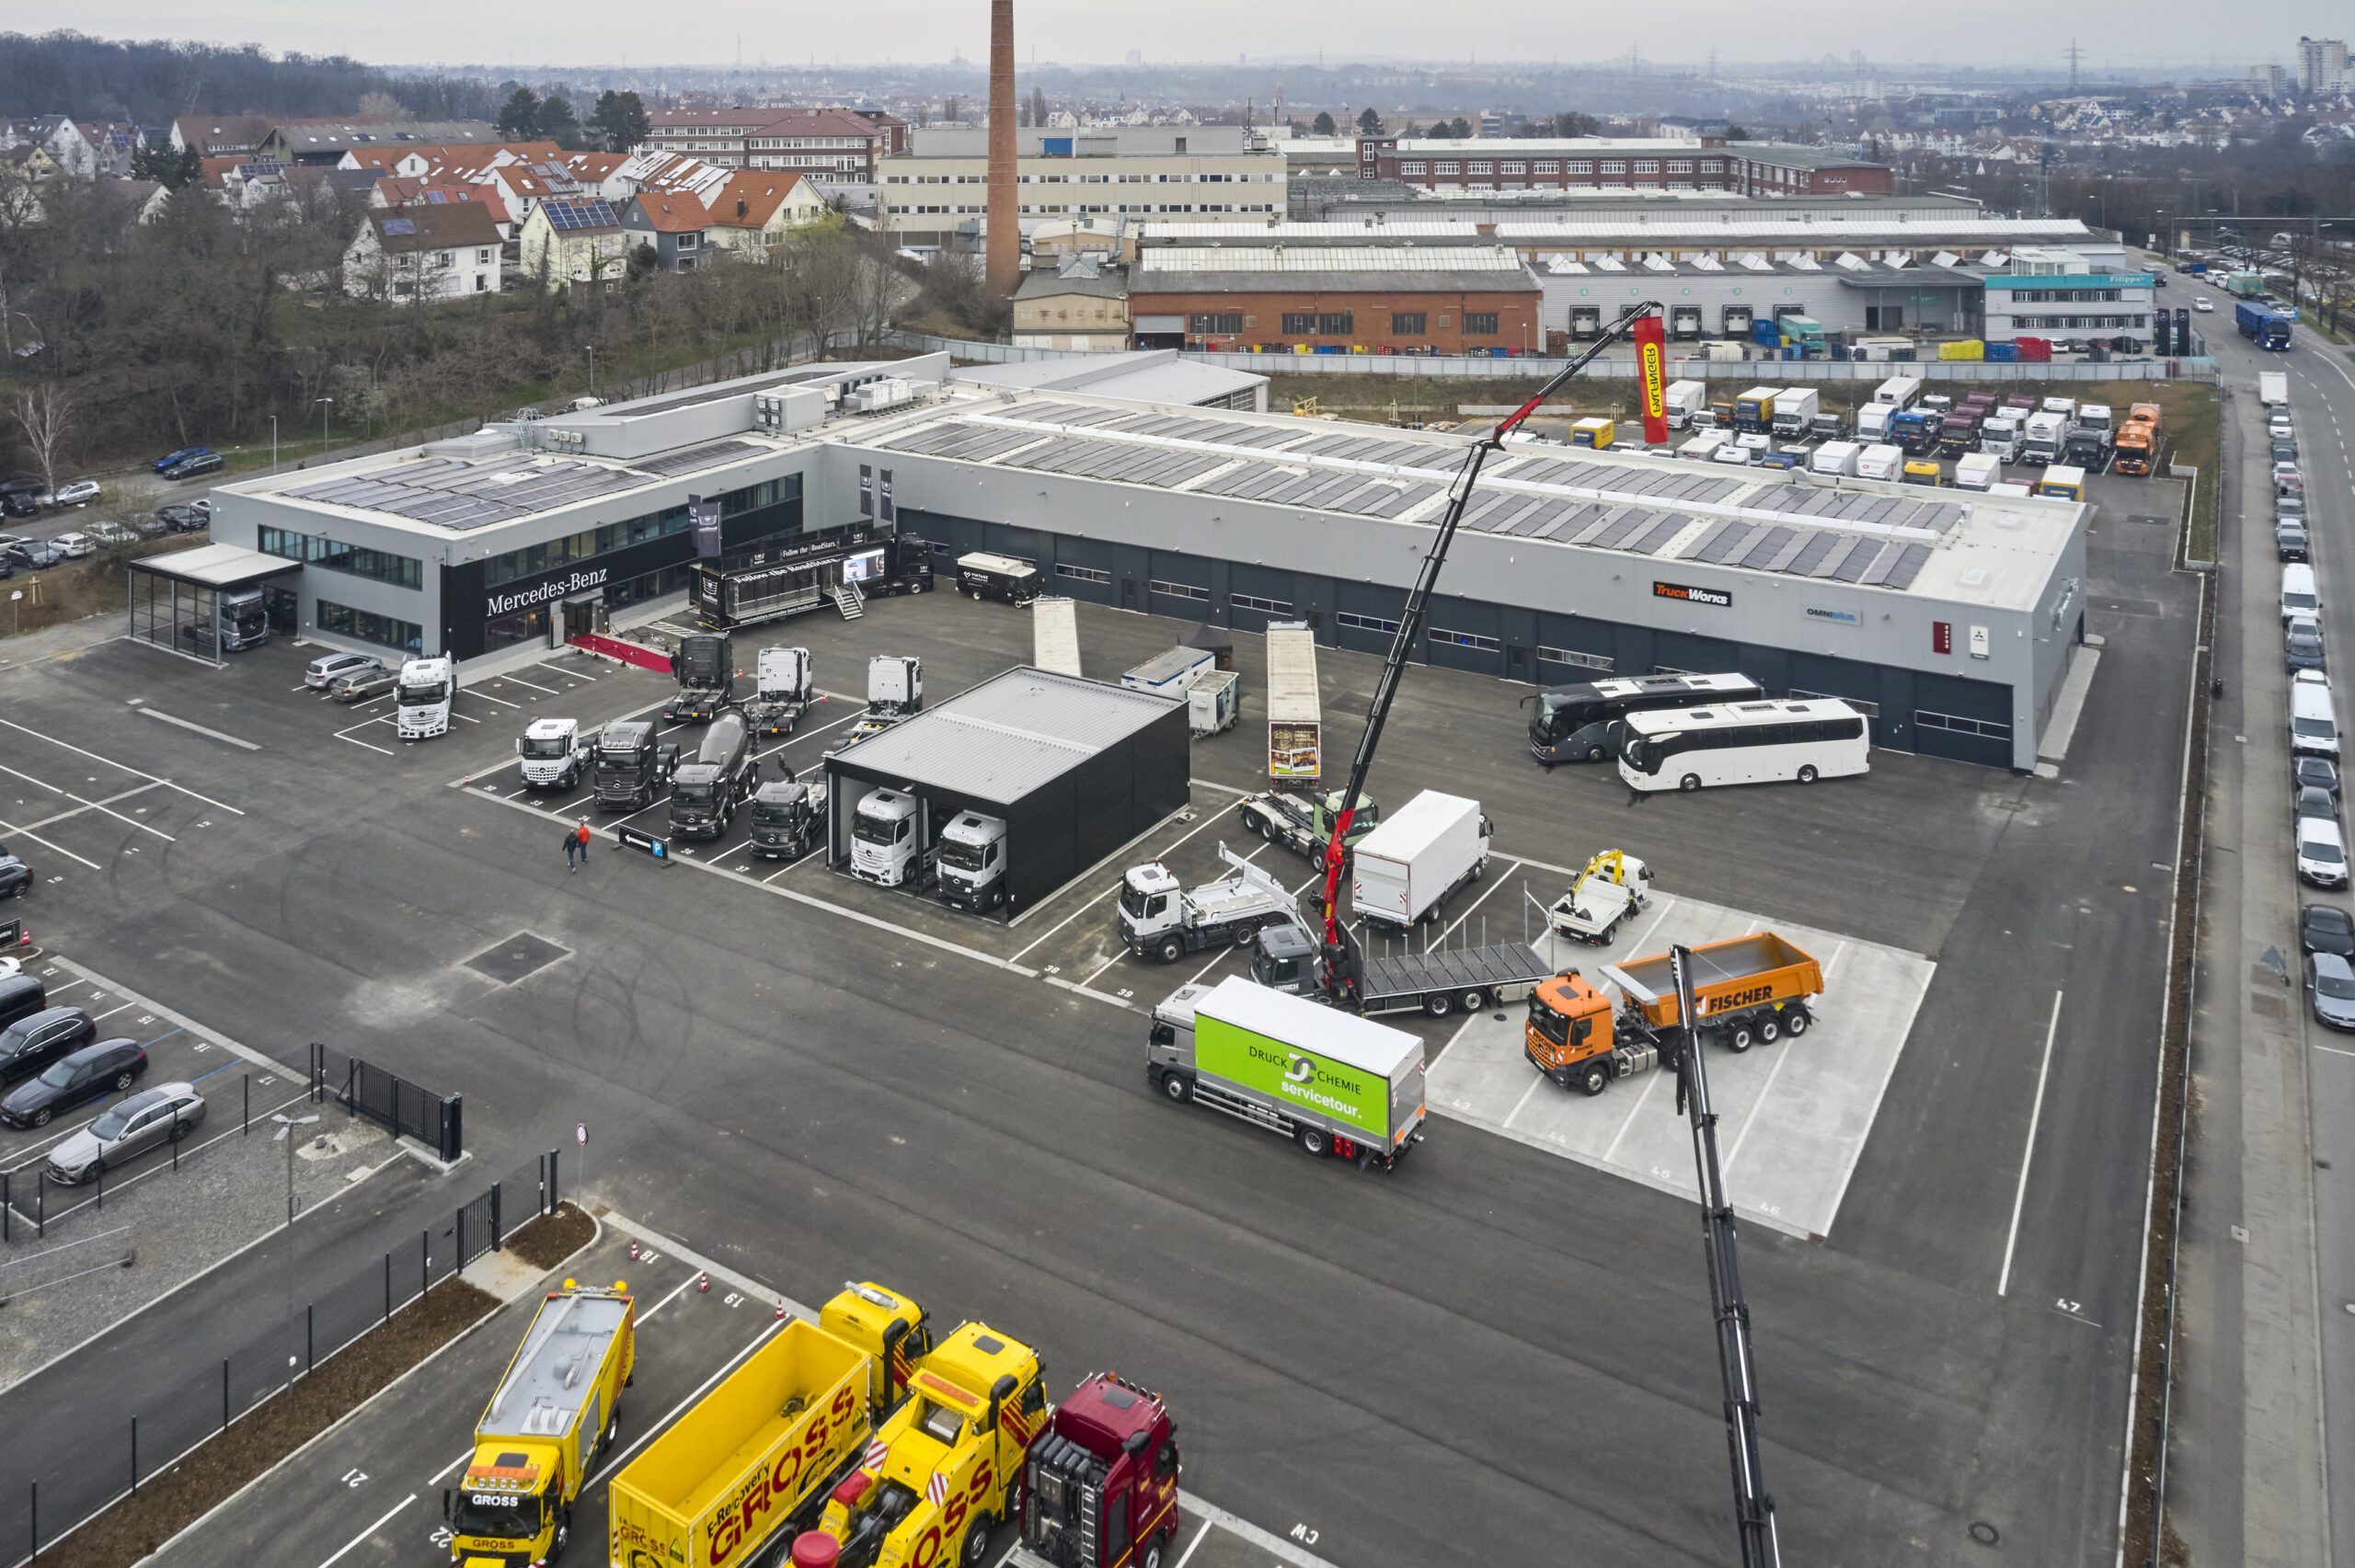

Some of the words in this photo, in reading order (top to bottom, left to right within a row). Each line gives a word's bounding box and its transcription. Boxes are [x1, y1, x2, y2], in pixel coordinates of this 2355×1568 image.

[783, 548, 798, 557] Follow
[799, 545, 809, 554] the
[487, 567, 607, 617] Mercedes-Benz
[654, 841, 661, 853] P
[1117, 988, 1134, 998] 39
[1709, 986, 1773, 1013] FISCHER
[1249, 1046, 1288, 1069] DRUCK
[1317, 1070, 1361, 1095] CHEMIE
[1281, 1082, 1361, 1119] servicetour.
[1649, 1166, 1671, 1180] 45
[1759, 1202, 1781, 1216] 46
[639, 1251, 660, 1265] 18
[724, 1293, 745, 1308] 19
[2057, 1298, 2081, 1312] 47
[341, 1468, 369, 1487] 21
[709, 1385, 855, 1566] GROSS
[472, 1494, 518, 1506] GROSS
[706, 1461, 771, 1539] E-Recovery
[900, 1459, 993, 1568] OSS
[430, 1526, 454, 1549] 22
[473, 1539, 514, 1550] GROSS
[620, 1526, 667, 1558] GROSS
